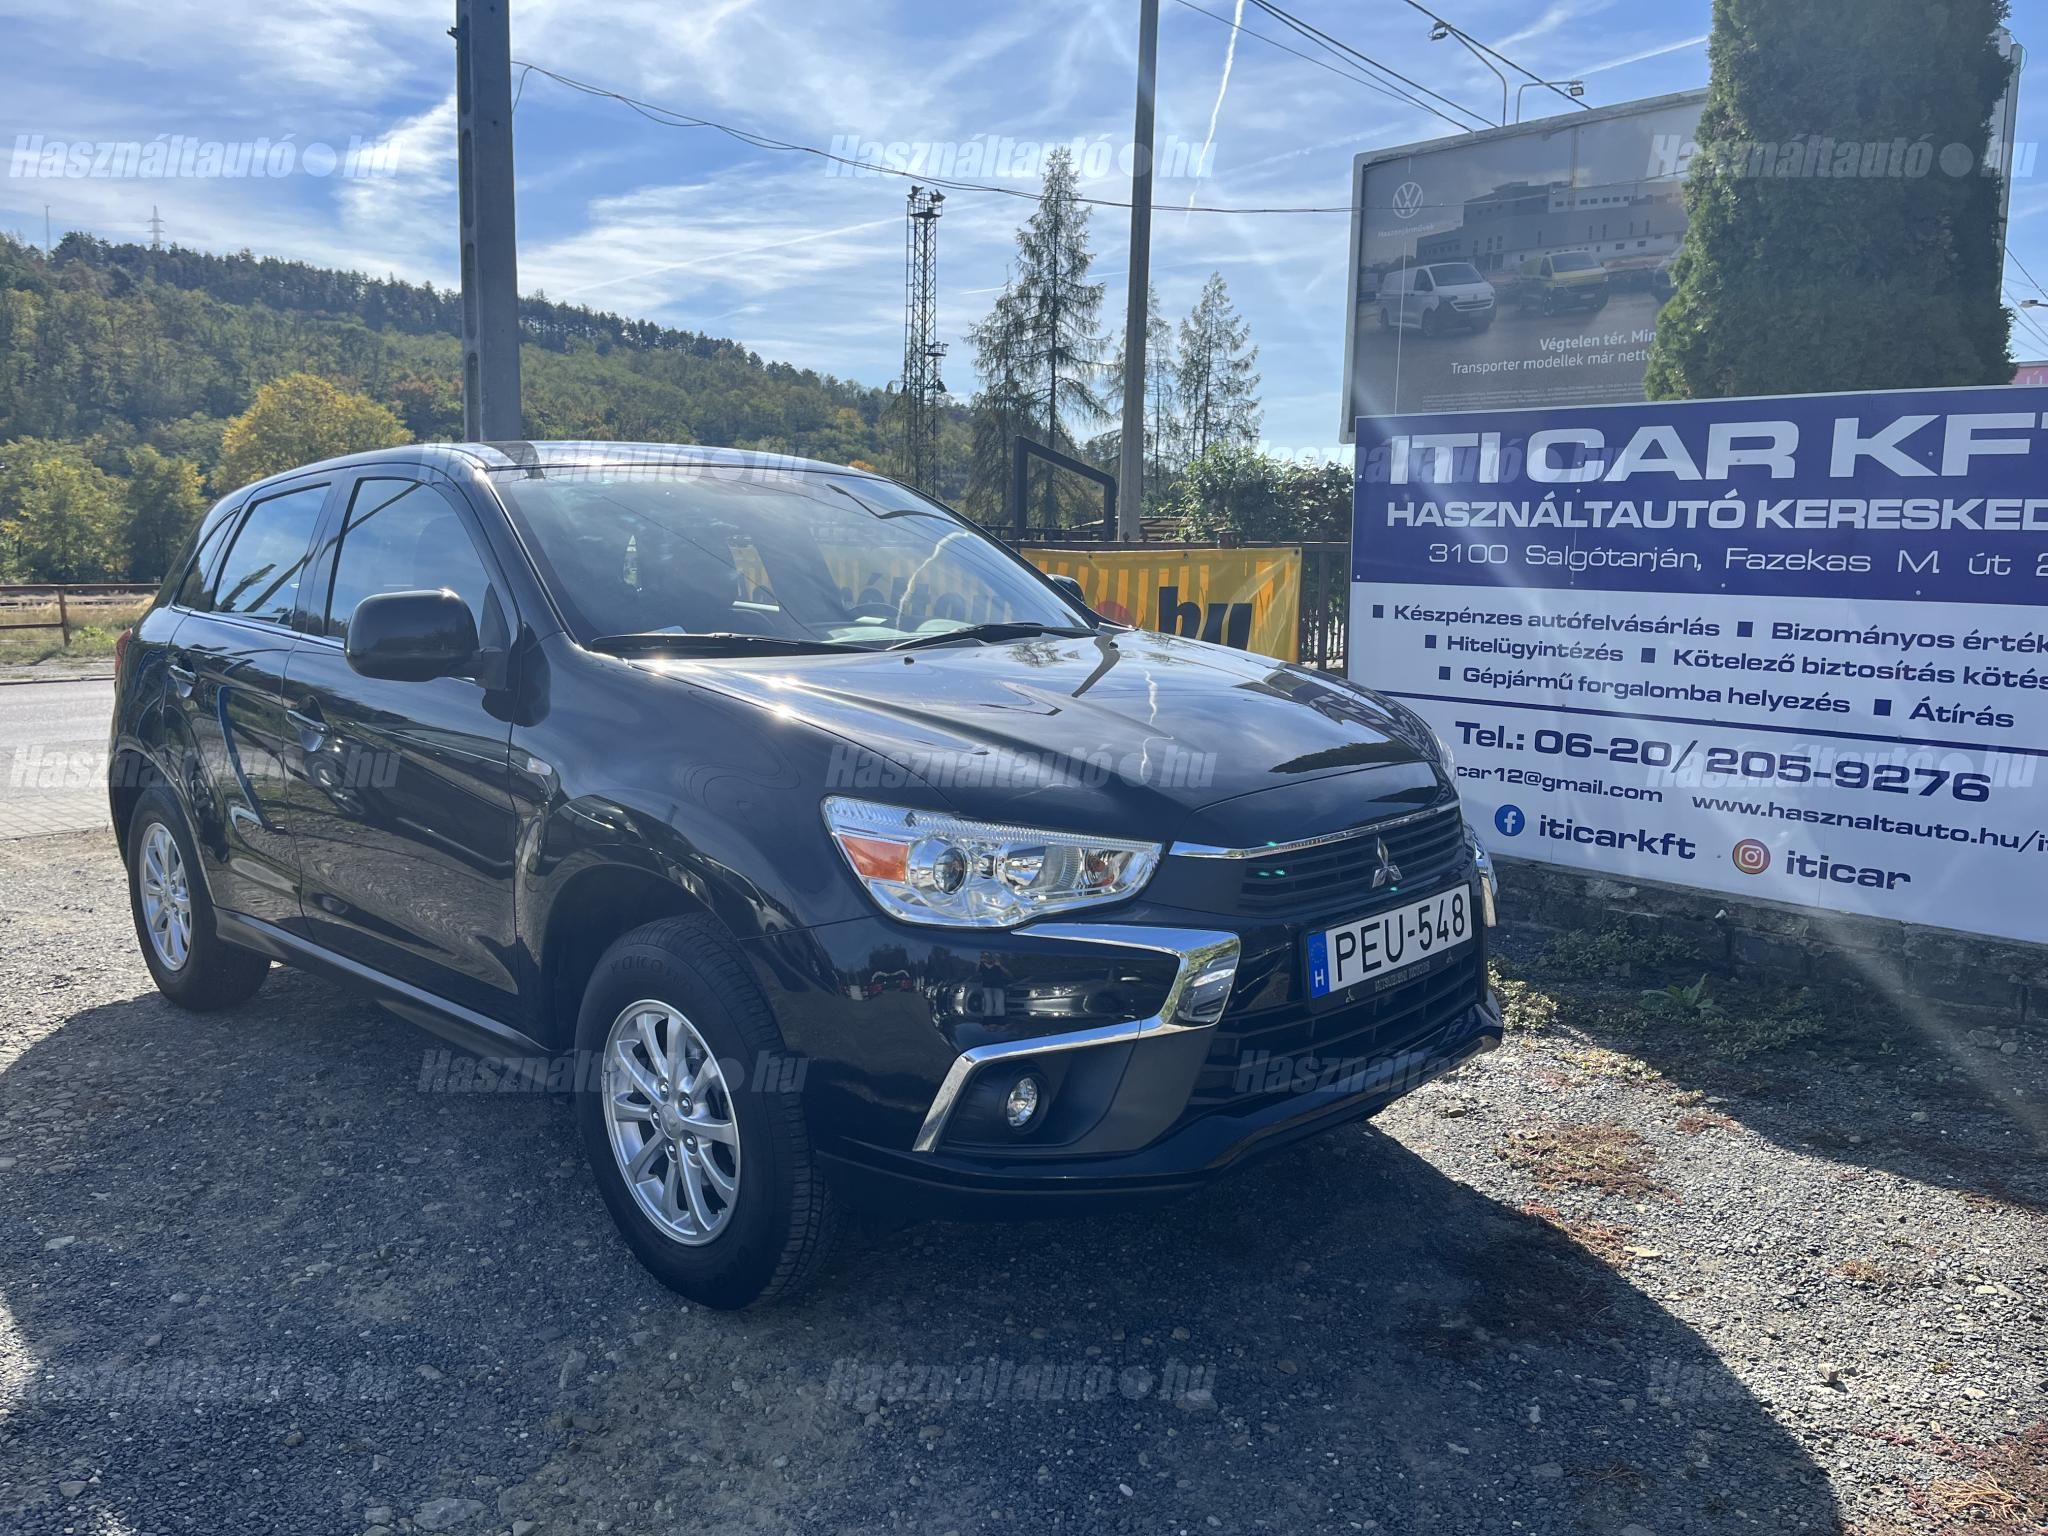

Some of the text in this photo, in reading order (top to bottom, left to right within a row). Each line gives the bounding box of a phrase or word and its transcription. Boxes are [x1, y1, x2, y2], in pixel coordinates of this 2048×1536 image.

[1540, 334, 1600, 352] Végtelen
[1603, 333, 1627, 347] tér.
[1451, 360, 1520, 375] Transporter
[1523, 352, 1583, 370] modellek
[1587, 350, 1615, 365] már
[1829, 411, 2048, 478] KF
[1387, 488, 1746, 529] HASZNÁLTAUTÓ
[1428, 543, 1508, 564] 3100
[1525, 544, 1702, 572] Salgótarján,
[1725, 547, 1872, 572] Fazekas
[1968, 552, 2012, 575] út
[1394, 604, 1720, 637] Készpénzes autófelvásárlás
[1771, 621, 1955, 652] Bizományos
[1447, 635, 1624, 662] Hitelügyintézés
[1673, 647, 1795, 674] Kötelező
[1801, 656, 1956, 684] biztosítás
[1463, 667, 1851, 714] Gépjármű forgalomba helyezés
[1908, 696, 2015, 728] Átírás
[1455, 720, 1525, 751] Tel.:
[1539, 814, 1696, 860] iticarkft
[1692, 796, 2048, 853] www.hasznaltauto.hu/i
[1786, 850, 1912, 890] iticar
[1335, 893, 1465, 982] PEU-548
